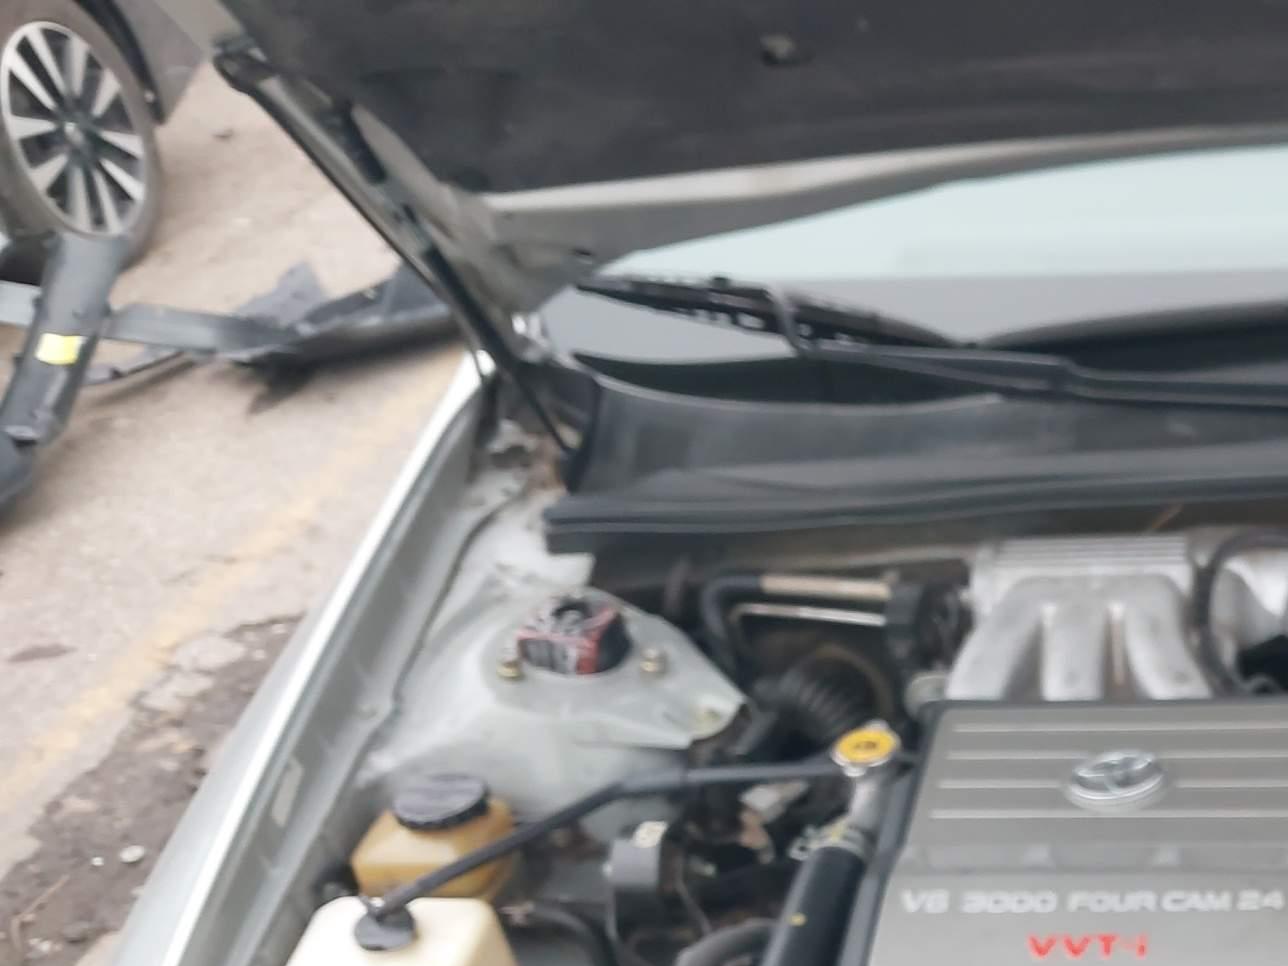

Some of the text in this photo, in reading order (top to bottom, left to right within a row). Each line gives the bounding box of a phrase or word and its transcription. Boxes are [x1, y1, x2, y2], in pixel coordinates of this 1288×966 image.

[960, 889, 1059, 913] 3000
[1066, 889, 1158, 913] FOUR
[1162, 889, 1232, 912] CAM
[1237, 889, 1284, 911] 24
